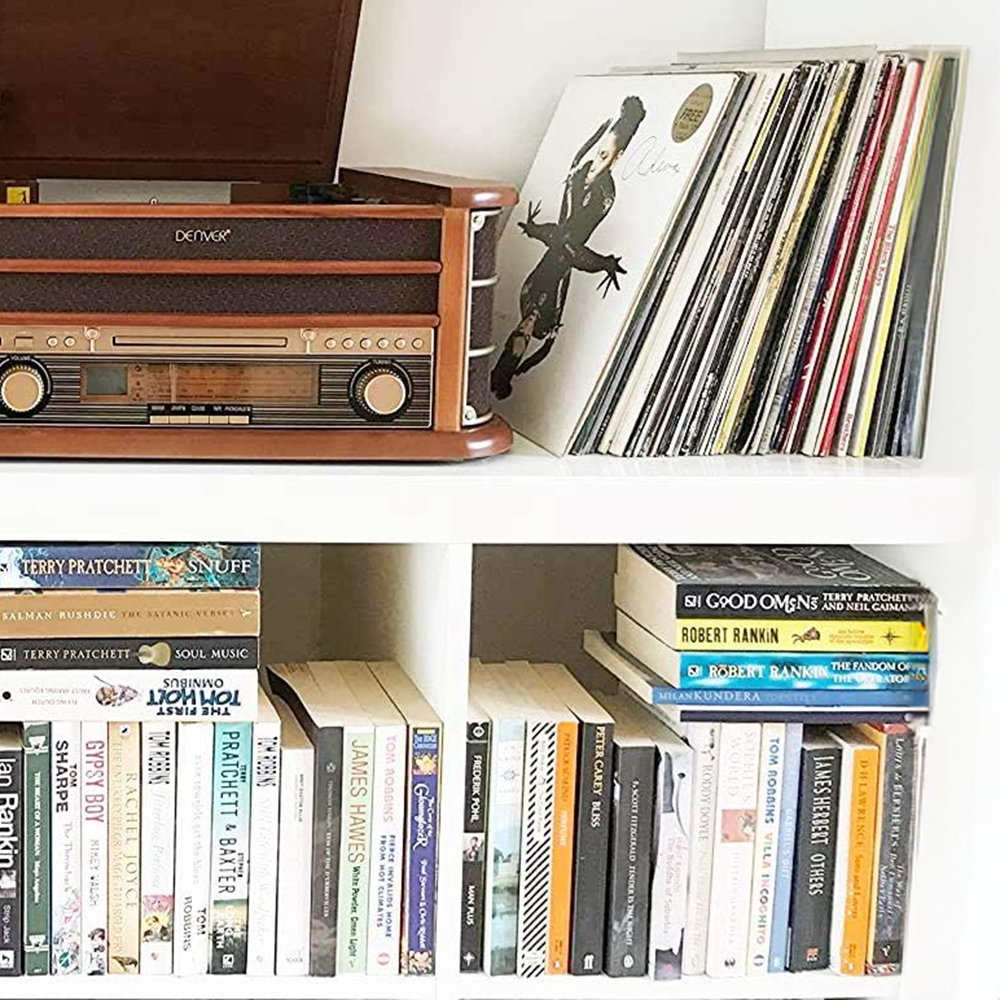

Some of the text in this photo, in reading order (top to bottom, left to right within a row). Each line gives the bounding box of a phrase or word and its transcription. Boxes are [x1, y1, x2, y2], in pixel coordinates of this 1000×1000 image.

[174, 229, 228, 242] DENVER
[21, 558, 251, 576] TERRY PRATCHETT SNUFF
[1, 611, 51, 621] SALMAN
[58, 610, 117, 620] RUSHDIE
[122, 609, 143, 619] THE
[147, 609, 191, 619] SATANIC
[705, 592, 820, 615] GOOD OMENS
[681, 627, 727, 644] ROBERT
[23, 648, 250, 659] TERRY PRATCHETT SOUL MUSIC
[709, 663, 828, 680] ROBERT RANKIN
[831, 661, 851, 671] THE
[852, 661, 896, 671] FANDOM
[163, 677, 224, 689] OMNIBUS
[146, 689, 241, 707] TOM HOLT
[659, 691, 761, 702] MILAN KUNDERA
[156, 706, 231, 716] THE FIRST
[147, 730, 171, 785] TOM ROBBINS
[256, 736, 278, 787] TOM ROBBINS
[55, 740, 69, 813] SHARPE
[69, 764, 77, 788] TOM
[85, 740, 105, 824] GYPSY BOY
[239, 764, 247, 783] TERRY
[383, 735, 396, 822] TOM ROBBINS
[590, 725, 606, 828] PETER CAREY BLISS
[700, 765, 714, 804] RODDY
[218, 731, 241, 894] PRATCHETT & BAXTER
[347, 739, 368, 863] JAMES HAWES
[698, 807, 711, 842] DOYLE
[808, 756, 835, 896] JAMES HERBERT OTHERS
[124, 772, 139, 910] RACHEL JOYCE
[465, 754, 484, 926] FREDERIK POHL MAN PLUS
[757, 737, 780, 945] TOM ROBBINS VILLA INCOGNITO
[351, 866, 361, 887] White
[375, 834, 387, 928] FROM HOT CLIMATES
[384, 834, 396, 938] FIERCE INVALIDS HOME
[1, 904, 12, 924] Strip
[182, 896, 193, 952] ROBBINS
[196, 907, 207, 936] TOM
[349, 916, 359, 936] Green
[2, 925, 12, 944] Jack
[347, 938, 359, 957] Light
